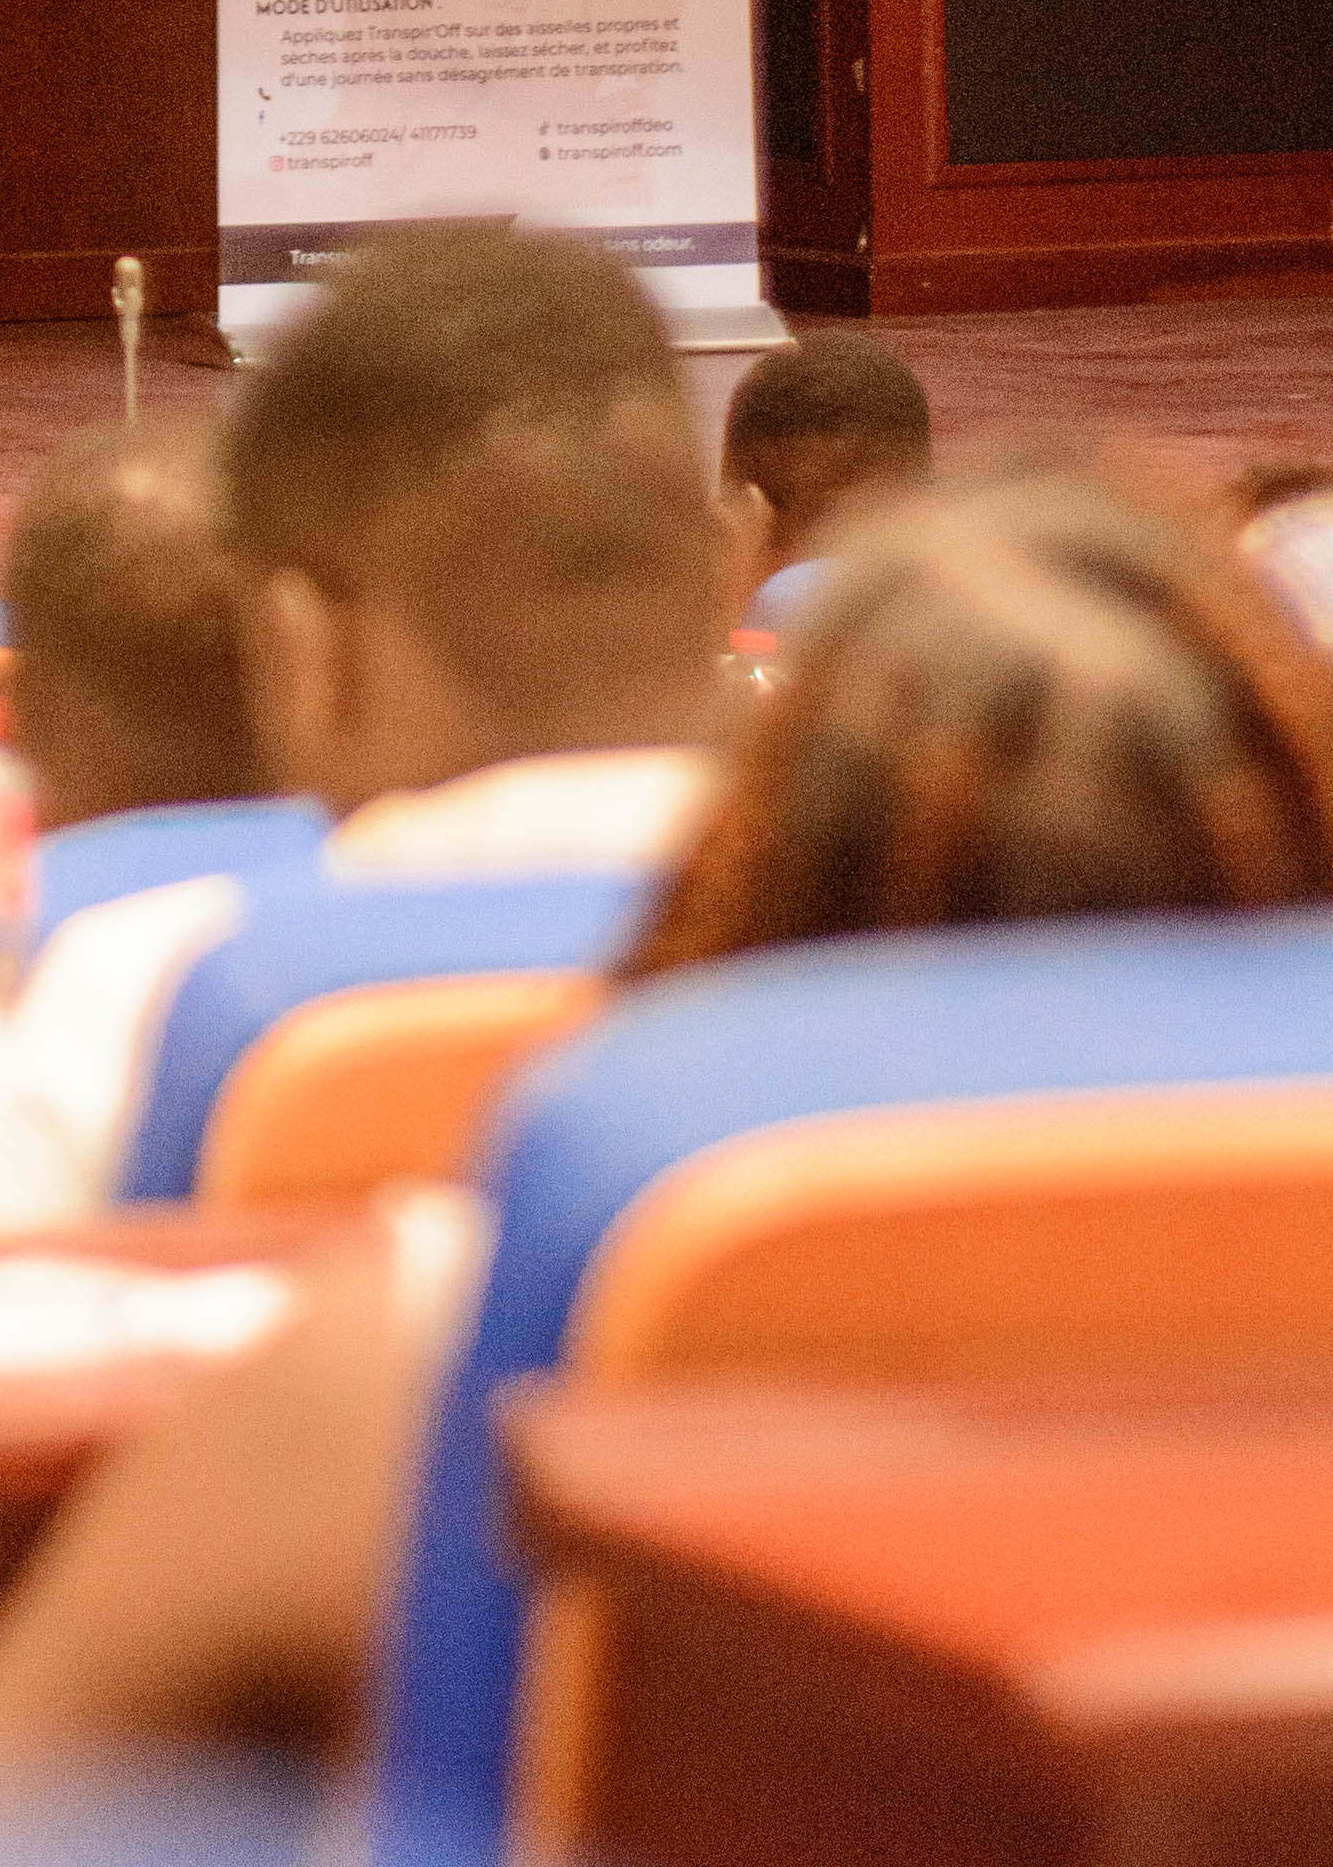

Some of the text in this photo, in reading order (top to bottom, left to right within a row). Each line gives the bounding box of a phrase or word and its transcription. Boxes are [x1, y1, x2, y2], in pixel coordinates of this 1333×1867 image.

[464, 24, 491, 38] sur
[495, 22, 522, 36] des
[595, 18, 659, 35] propres
[397, 70, 433, 84] sans
[549, 63, 571, 77] de
